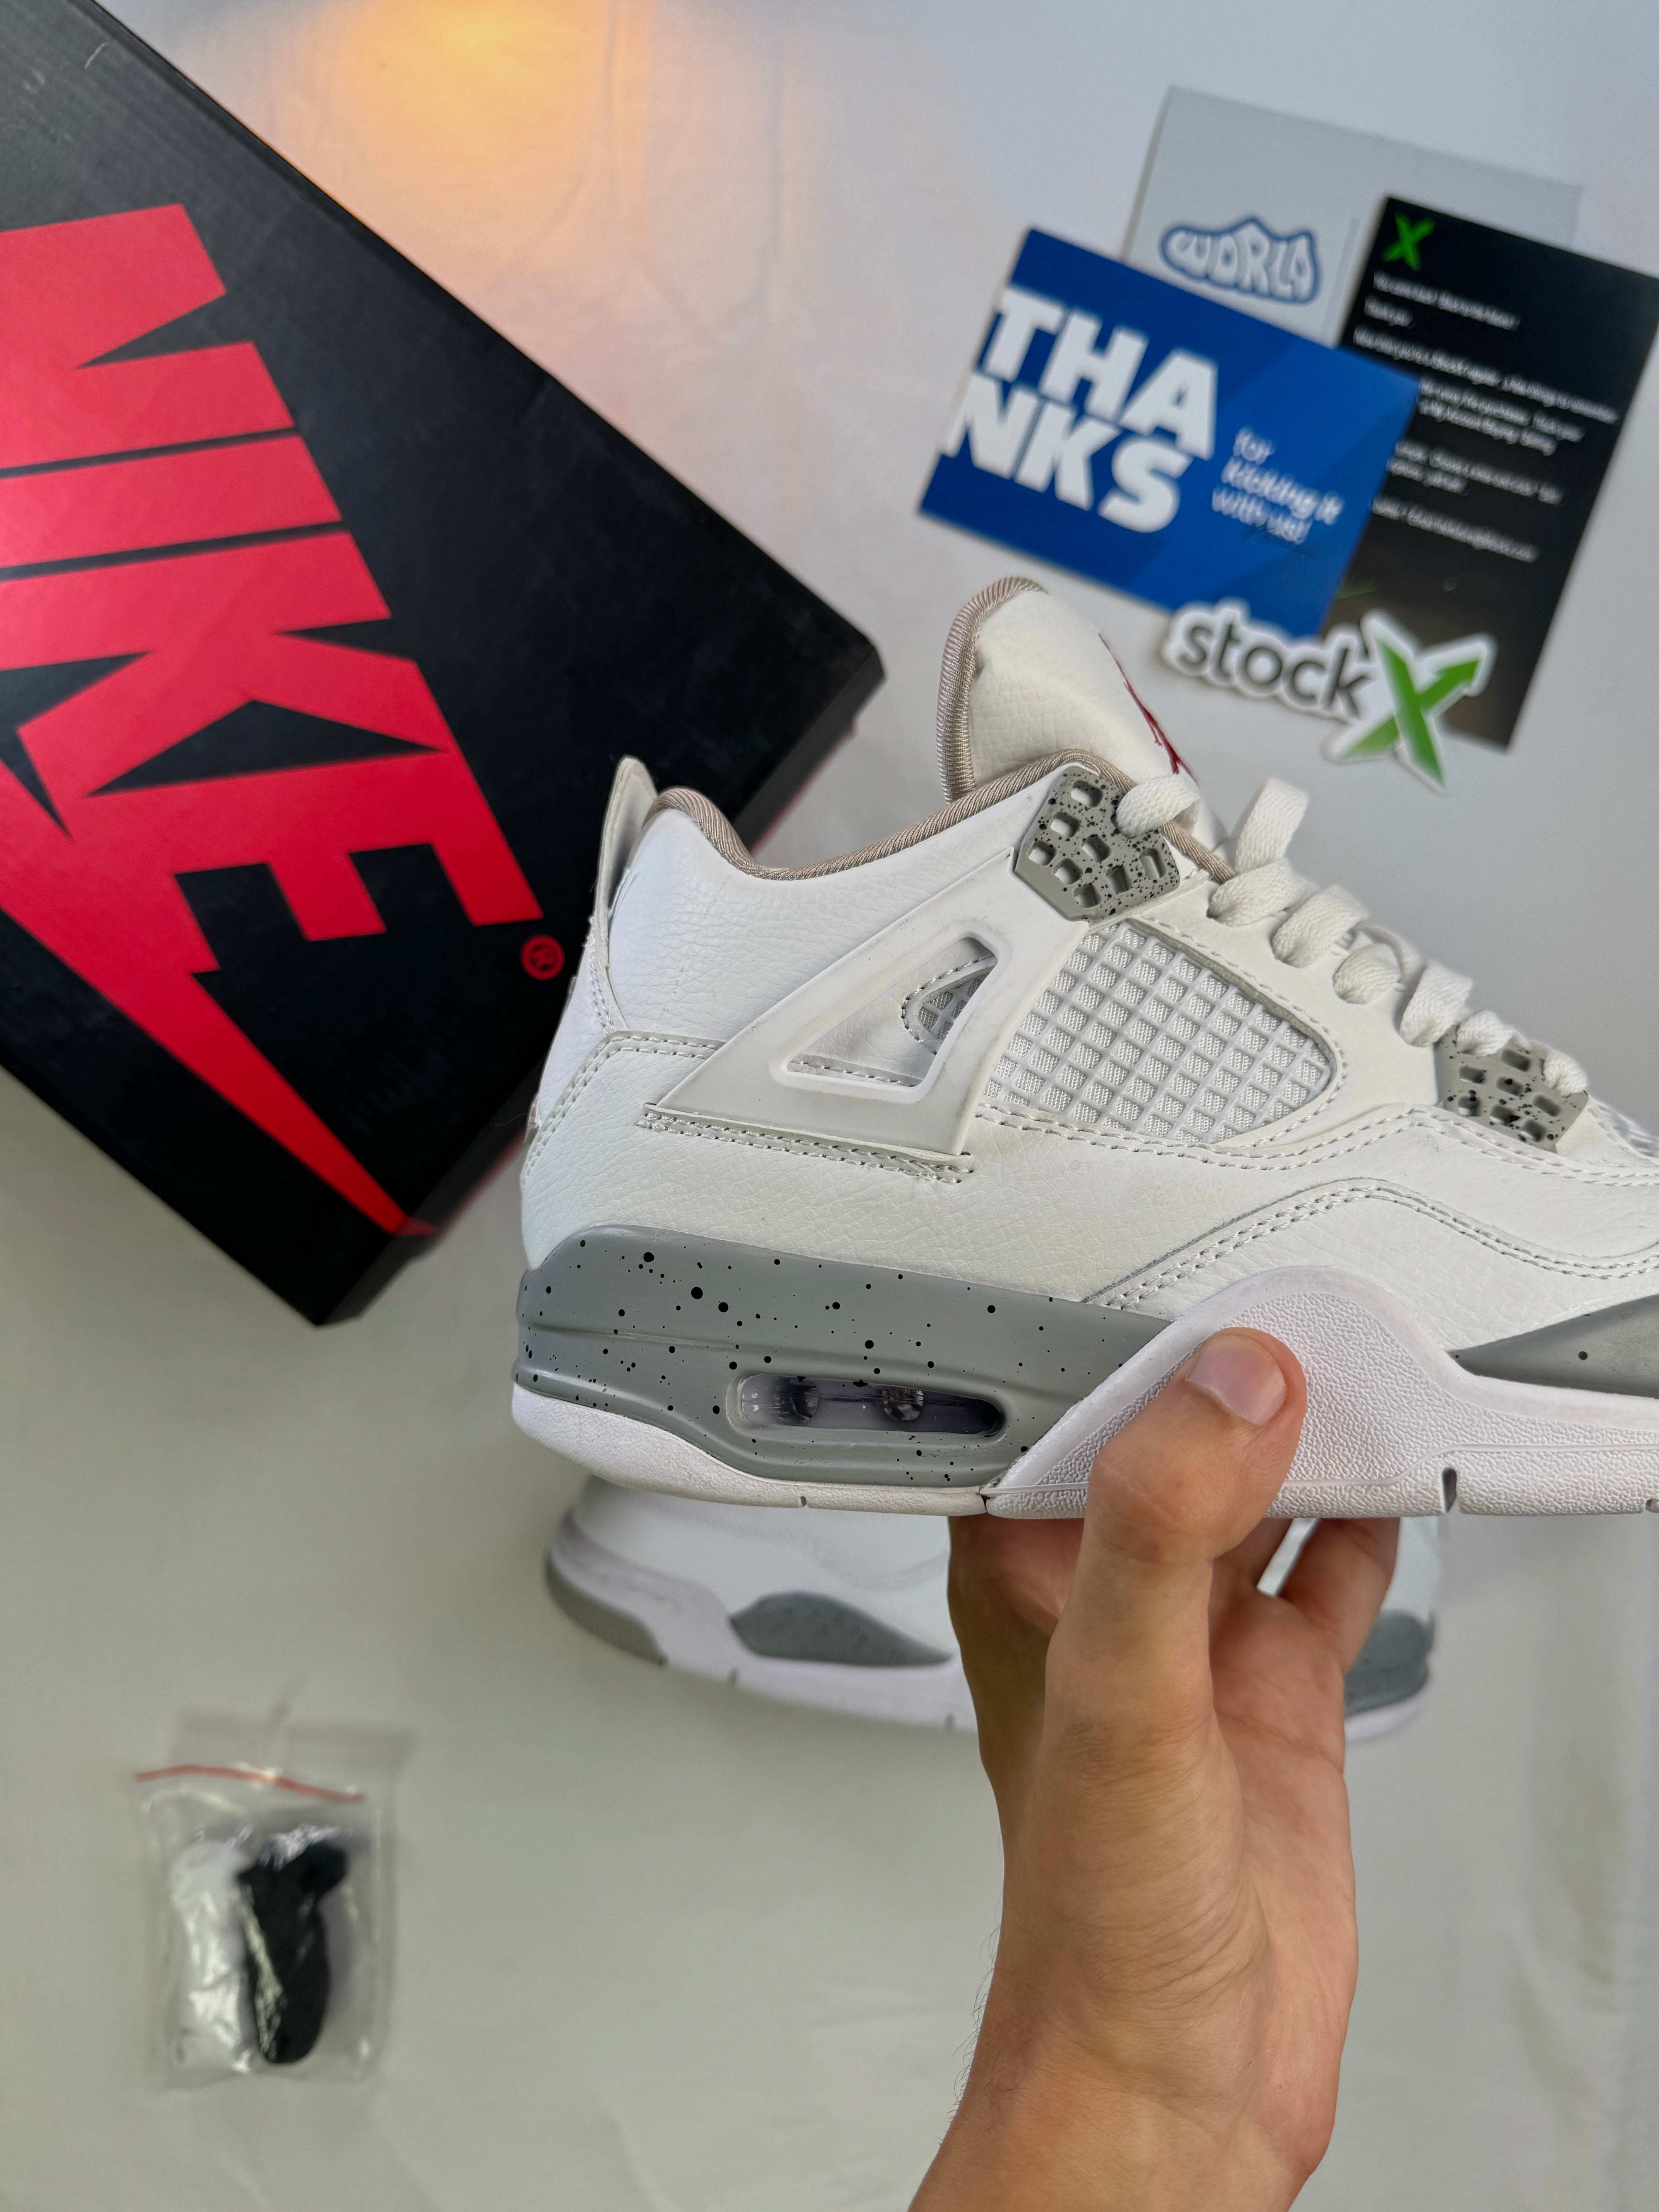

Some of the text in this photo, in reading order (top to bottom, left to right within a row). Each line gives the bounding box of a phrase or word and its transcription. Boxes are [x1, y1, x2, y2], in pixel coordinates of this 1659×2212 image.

[940, 373, 1194, 533] NKS
[983, 289, 1219, 460] THA
[0, 204, 544, 973] NIKE
[1211, 485, 1269, 527] with
